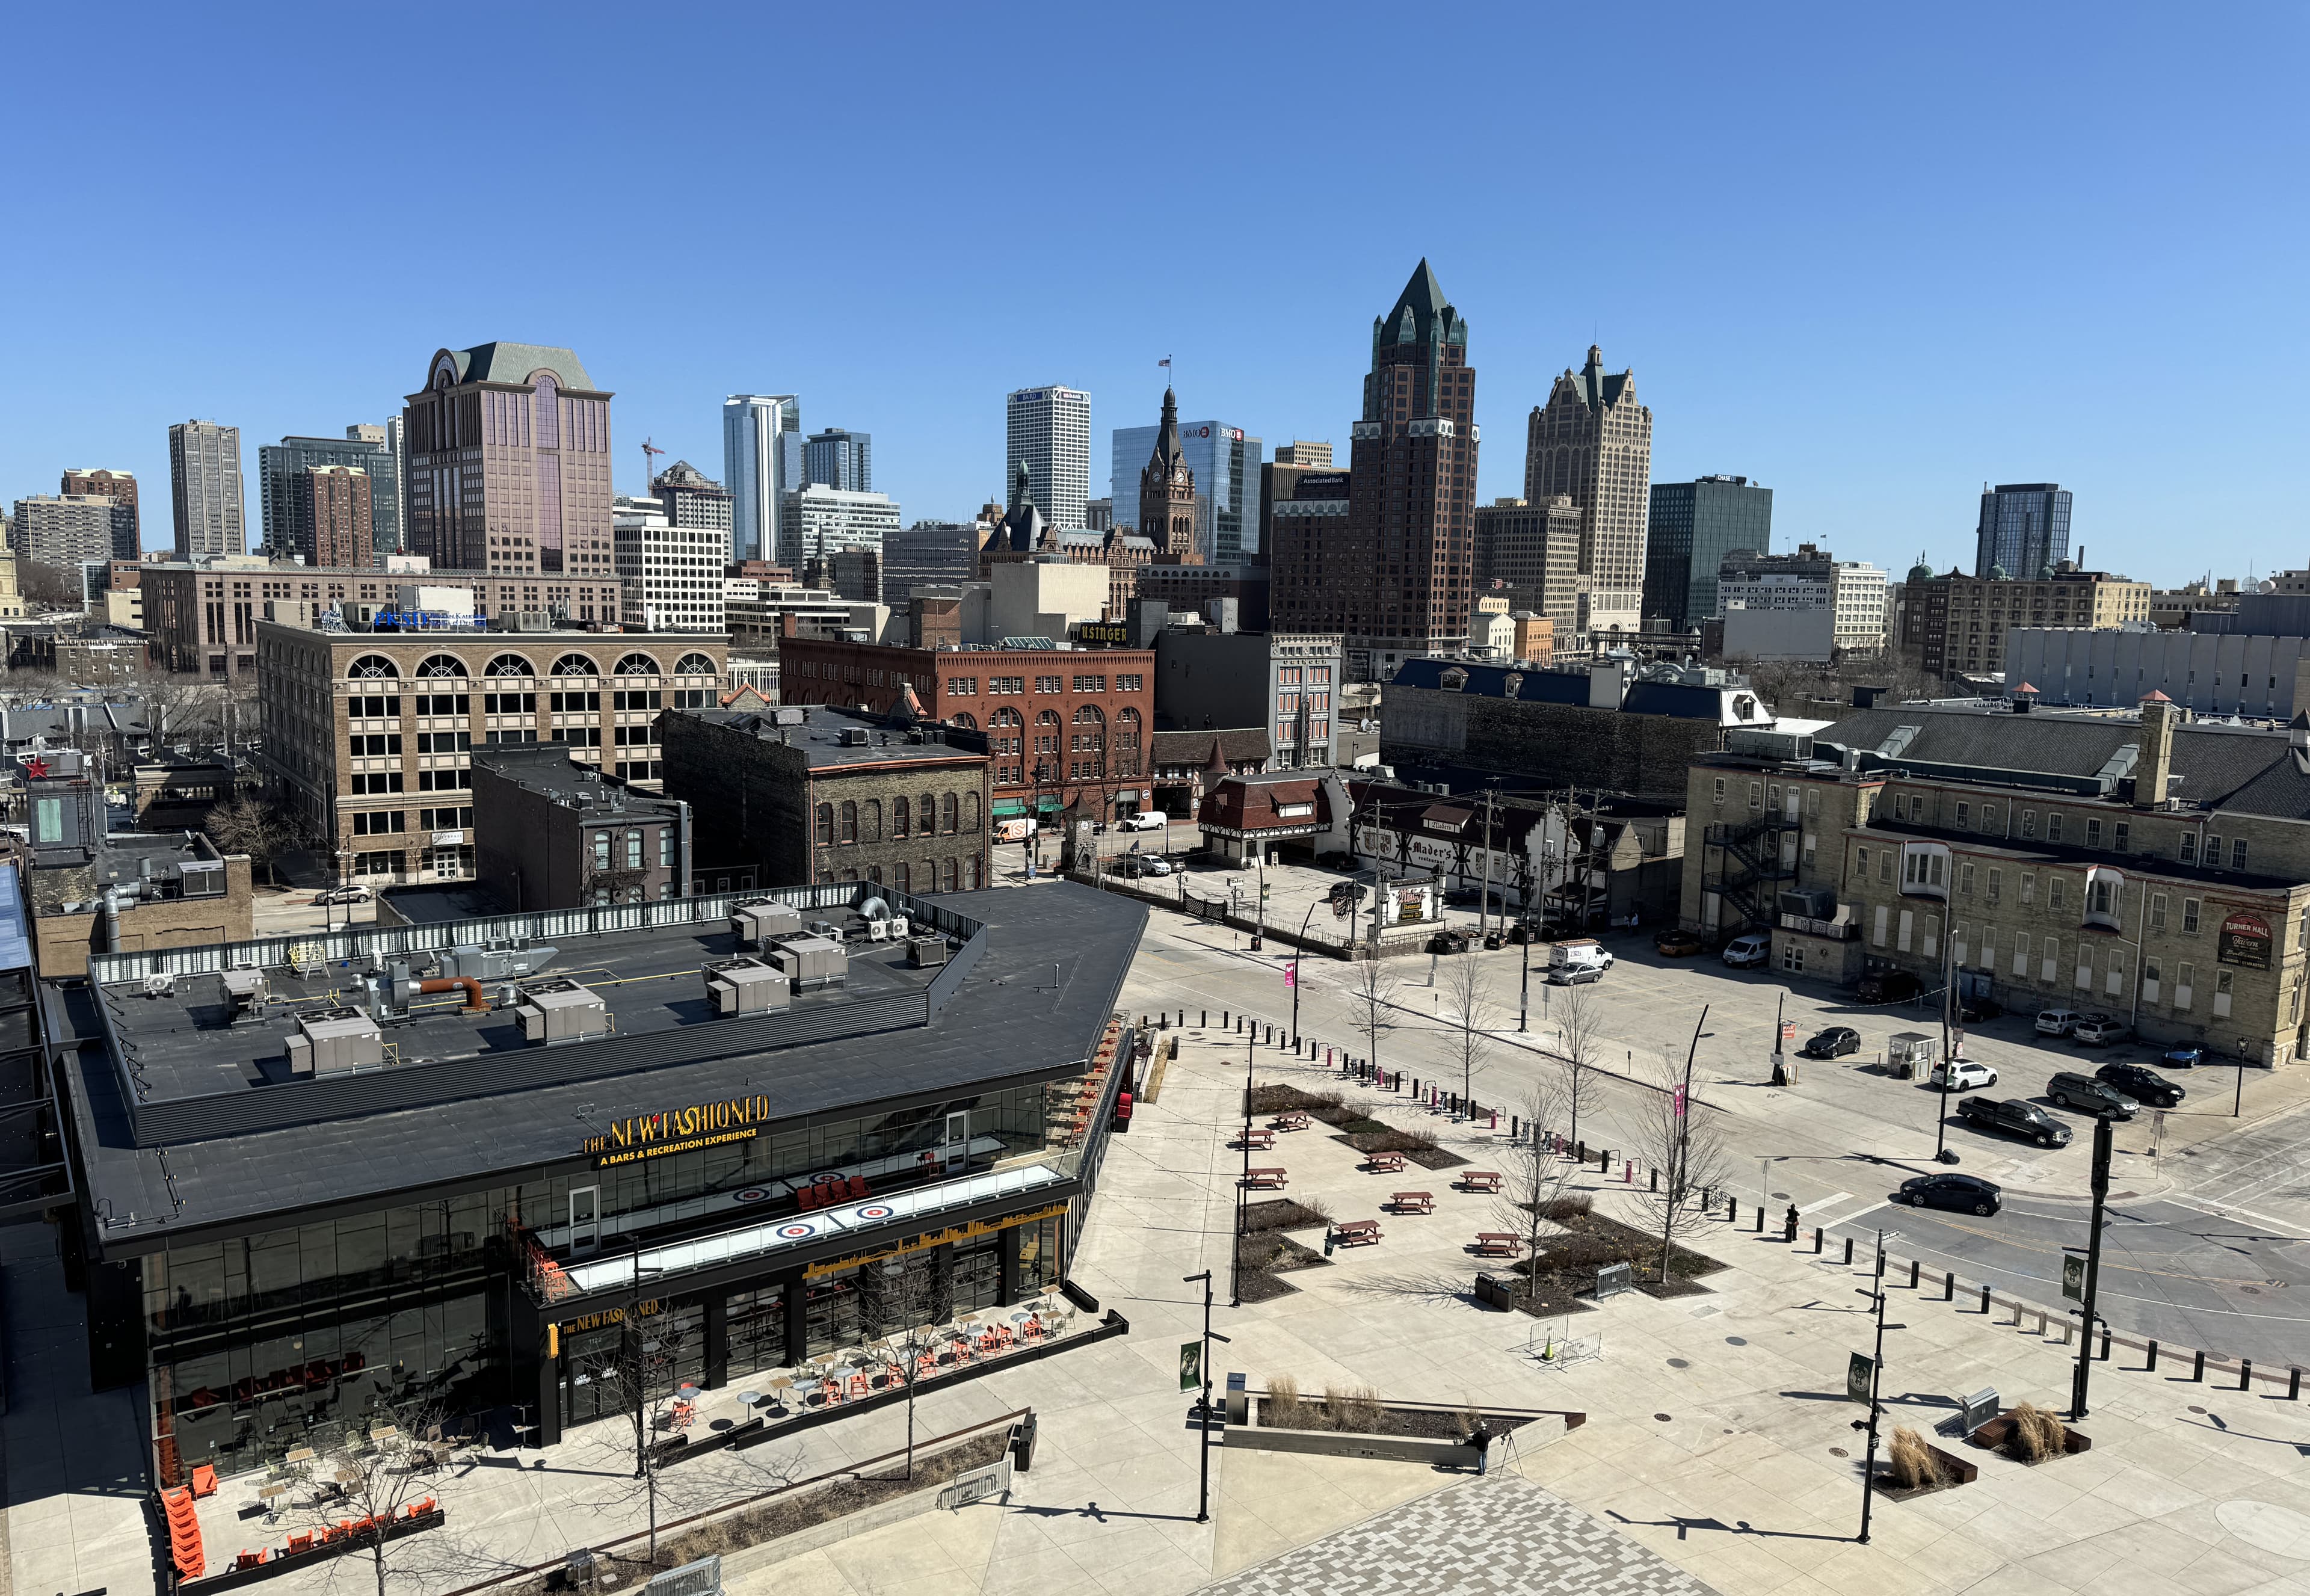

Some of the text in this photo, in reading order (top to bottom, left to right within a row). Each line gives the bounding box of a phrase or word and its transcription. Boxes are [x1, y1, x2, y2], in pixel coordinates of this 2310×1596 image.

[1183, 429, 1201, 438] BMO
[1221, 428, 1235, 438] BMO
[375, 611, 428, 626] PKSD
[1412, 841, 1452, 861] Mader's
[2226, 922, 2268, 937] TURNER HALL
[2232, 935, 2258, 947] Tavern
[583, 1094, 769, 1153] THE NEW FASHIONED
[600, 1128, 757, 1166] A BARS & RECREATION EXPERIENCE
[563, 1299, 659, 1334] THE NEW FASHNED
